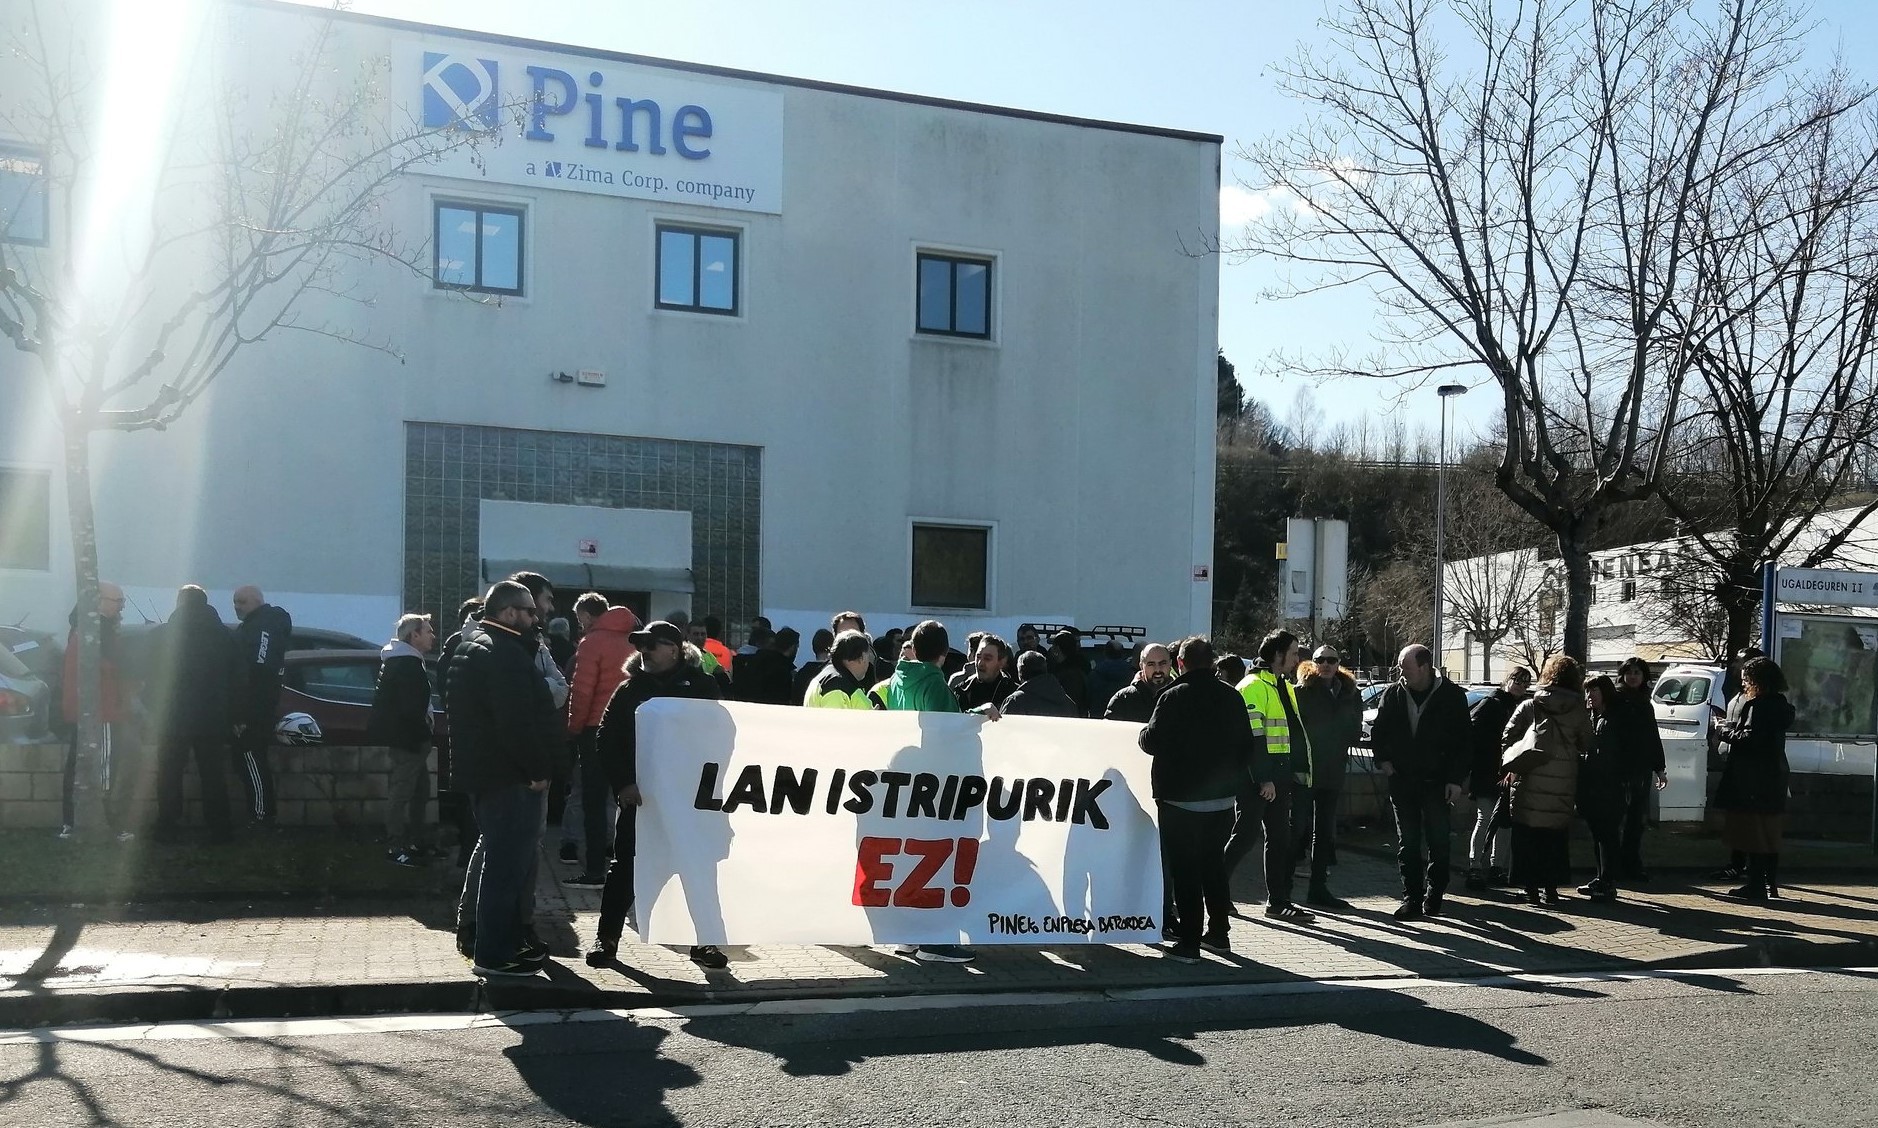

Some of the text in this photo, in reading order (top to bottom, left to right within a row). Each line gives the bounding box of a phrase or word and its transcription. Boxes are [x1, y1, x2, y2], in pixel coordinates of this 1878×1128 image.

[526, 65, 713, 160] Pine
[525, 163, 756, 203] a Zima Corp. company
[1781, 579, 1863, 593] UGALDEGUREN II
[693, 762, 1113, 830] LAN ISTRIPURIK
[851, 836, 980, 908] EZ!
